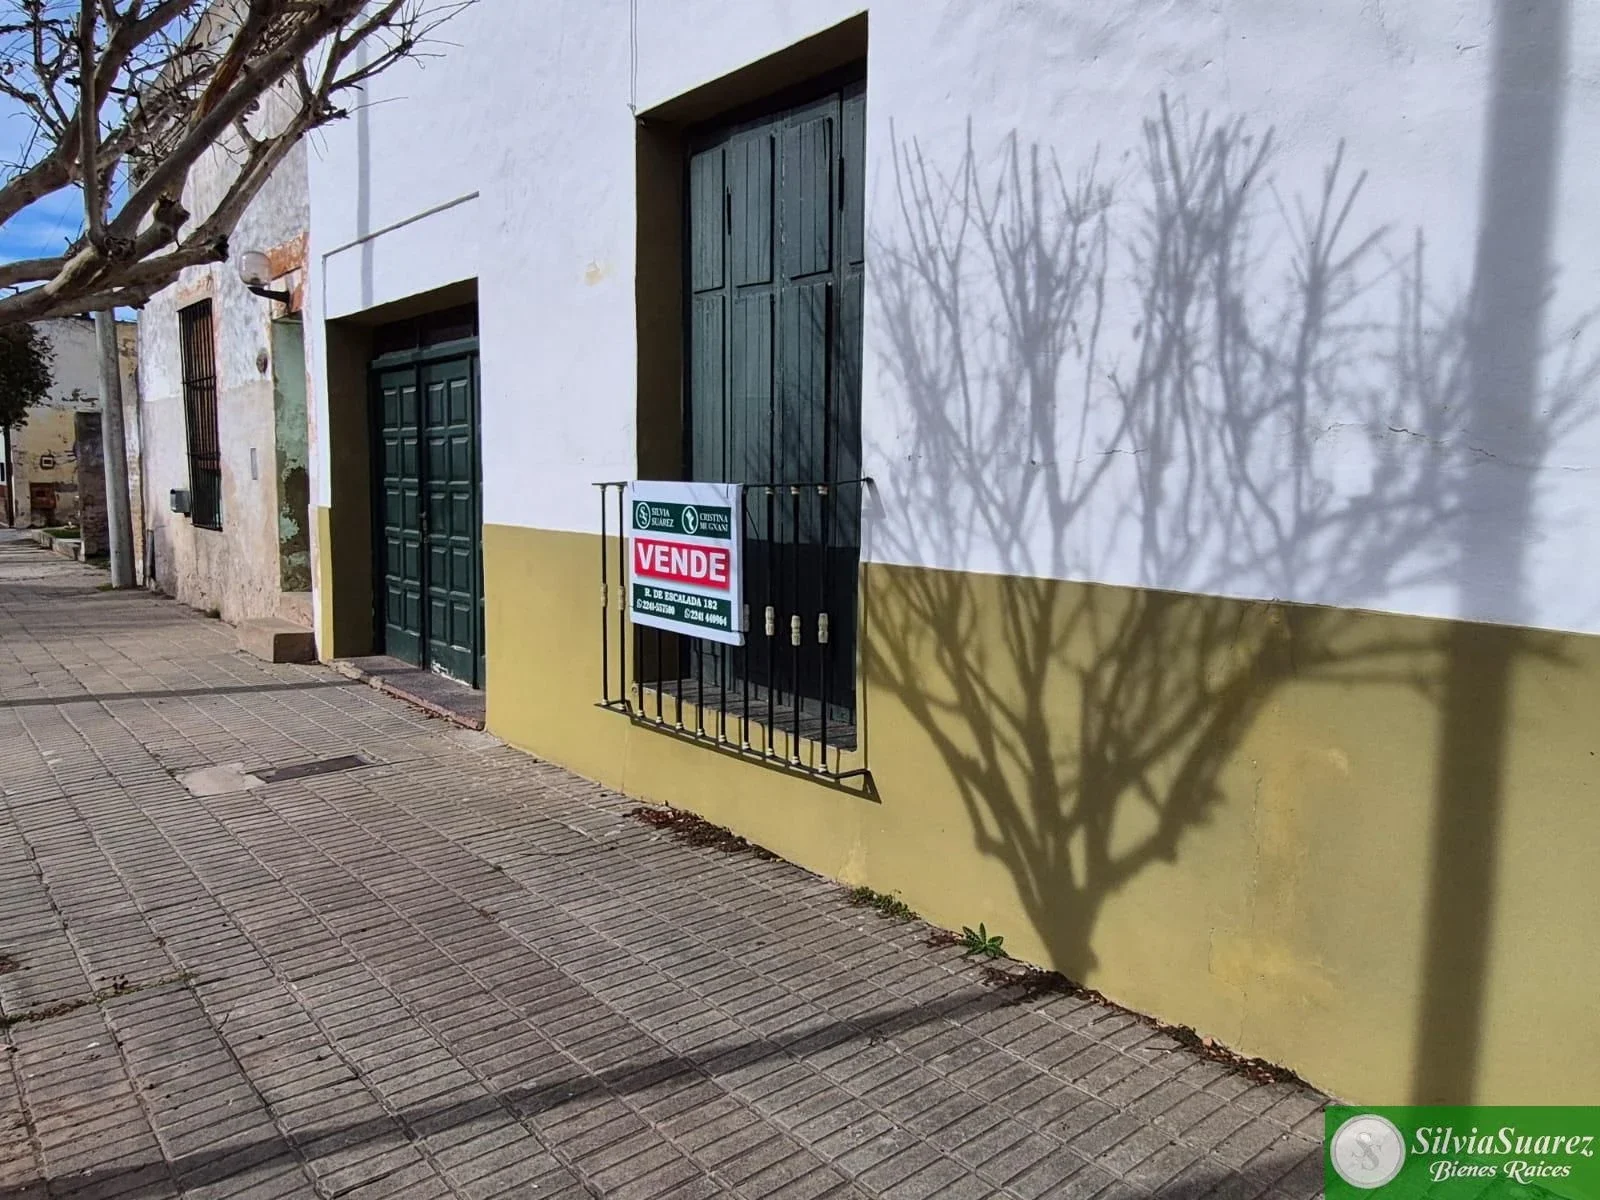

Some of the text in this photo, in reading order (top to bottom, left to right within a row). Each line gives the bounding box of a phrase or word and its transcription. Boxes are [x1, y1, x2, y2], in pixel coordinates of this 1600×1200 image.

[651, 507, 670, 517] SILVIA
[700, 512, 728, 523] CRISTINA
[637, 543, 725, 582] VENDE
[653, 590, 663, 600] DE
[664, 591, 702, 607] ESCALADA
[704, 599, 717, 610] 182
